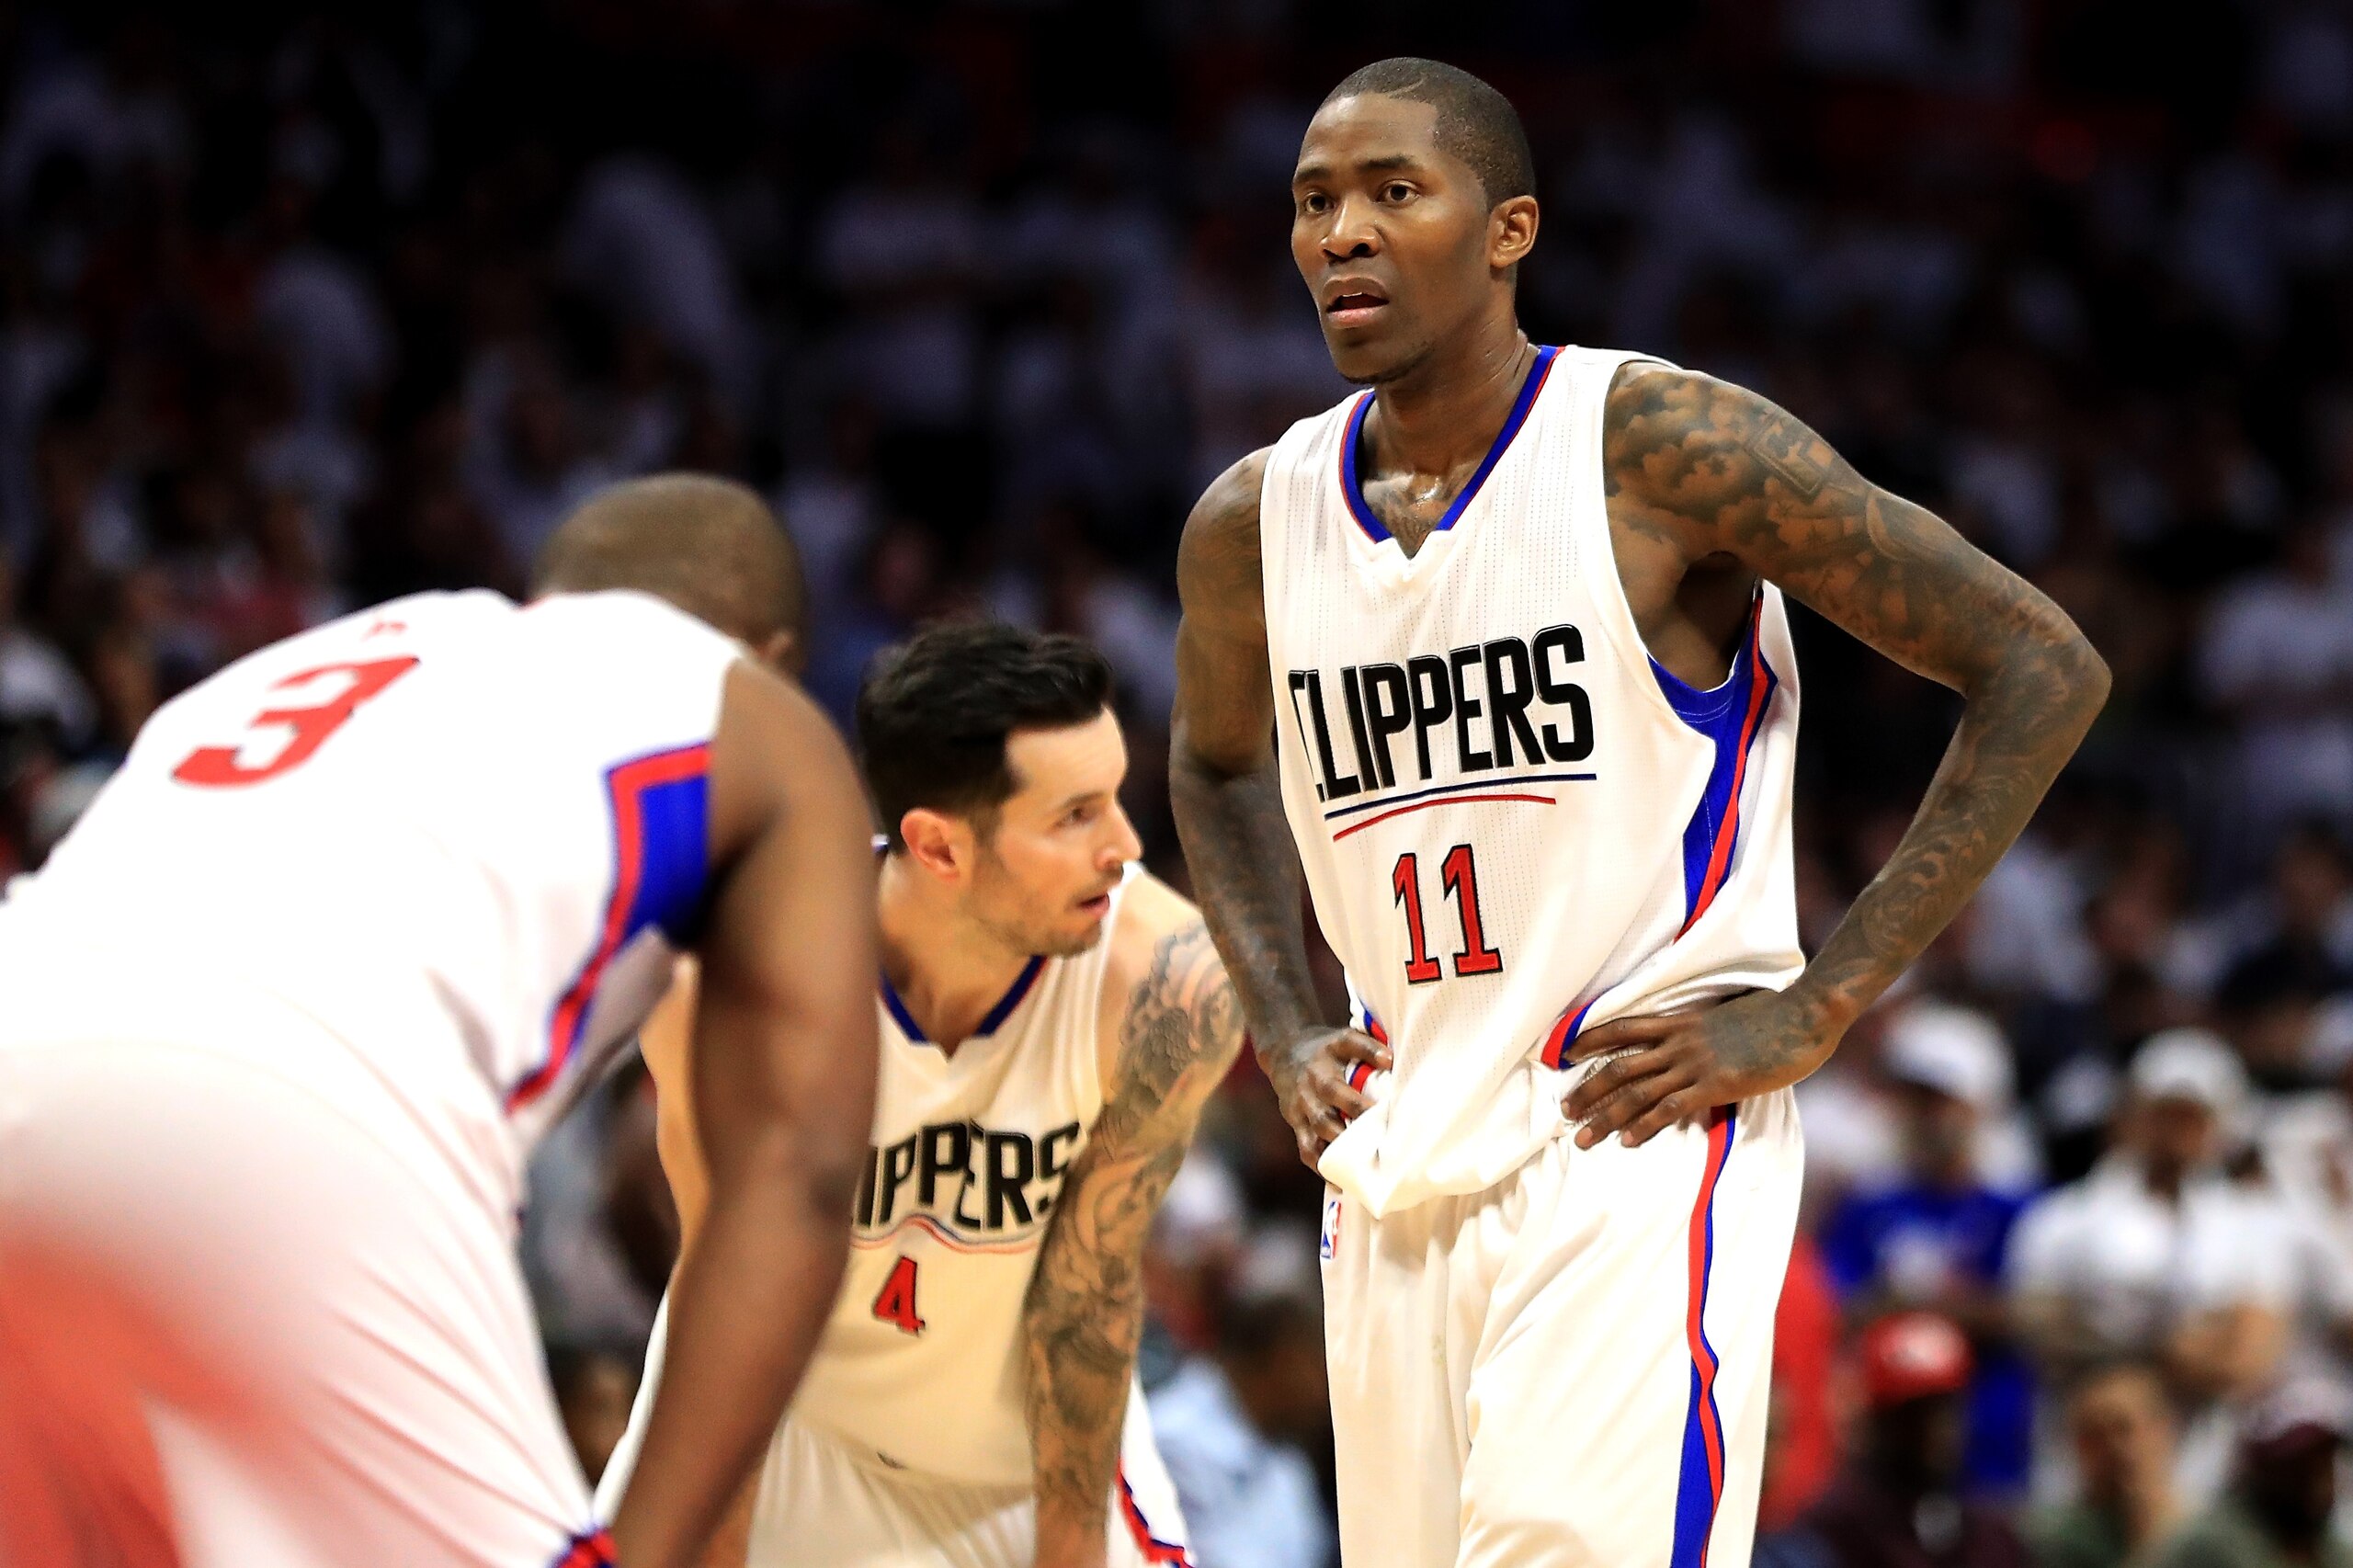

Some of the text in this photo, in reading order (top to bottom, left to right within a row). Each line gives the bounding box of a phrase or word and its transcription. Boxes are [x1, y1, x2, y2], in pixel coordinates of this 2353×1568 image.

[171, 653, 420, 790] 3
[1392, 844, 1504, 985] 11
[872, 1255, 926, 1336] 4
